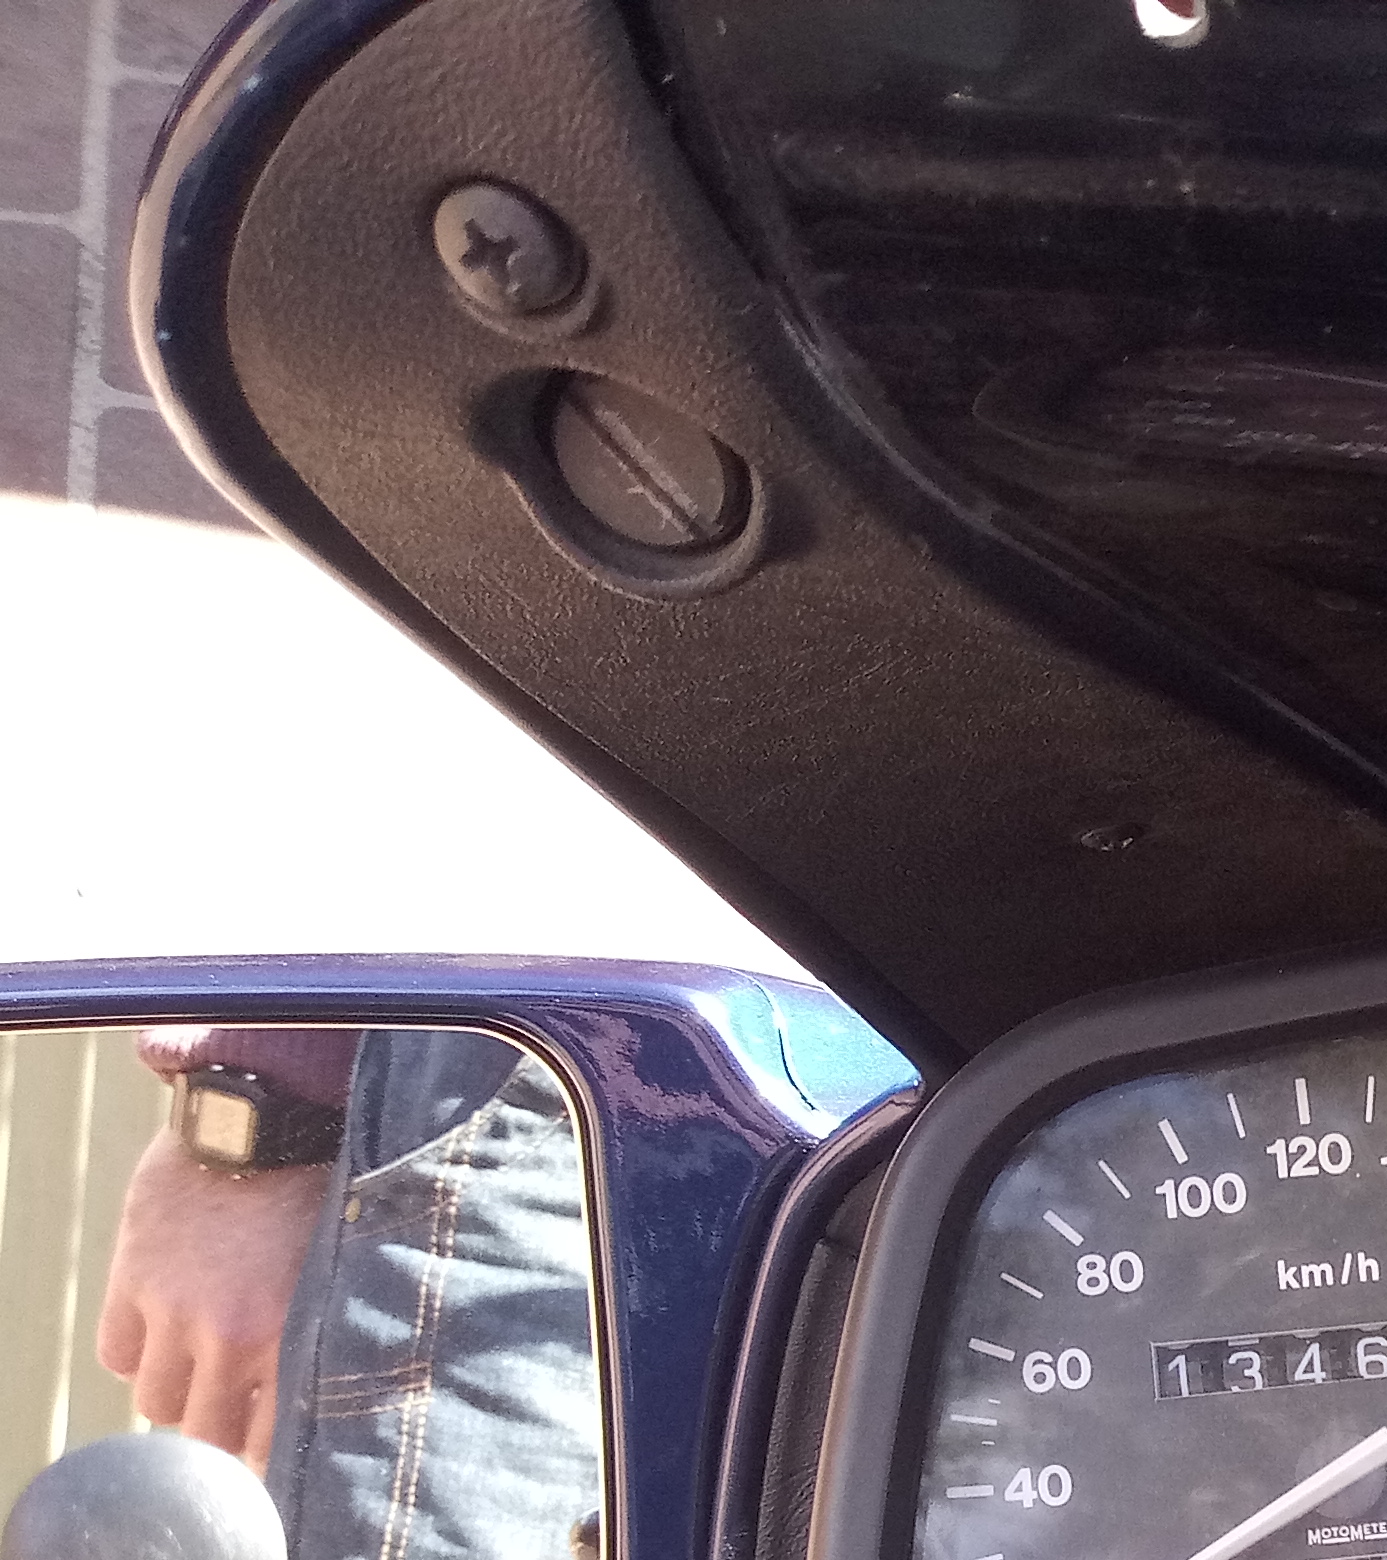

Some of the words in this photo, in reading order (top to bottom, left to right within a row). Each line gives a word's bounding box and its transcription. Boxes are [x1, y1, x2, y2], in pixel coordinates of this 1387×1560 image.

[1267, 1132, 1352, 1179] 120
[1155, 1172, 1248, 1220] 100
[1076, 1251, 1144, 1297] 80
[1277, 1251, 1381, 1293] km/h
[1022, 1346, 1092, 1394] 60
[1004, 1462, 1073, 1509] 40
